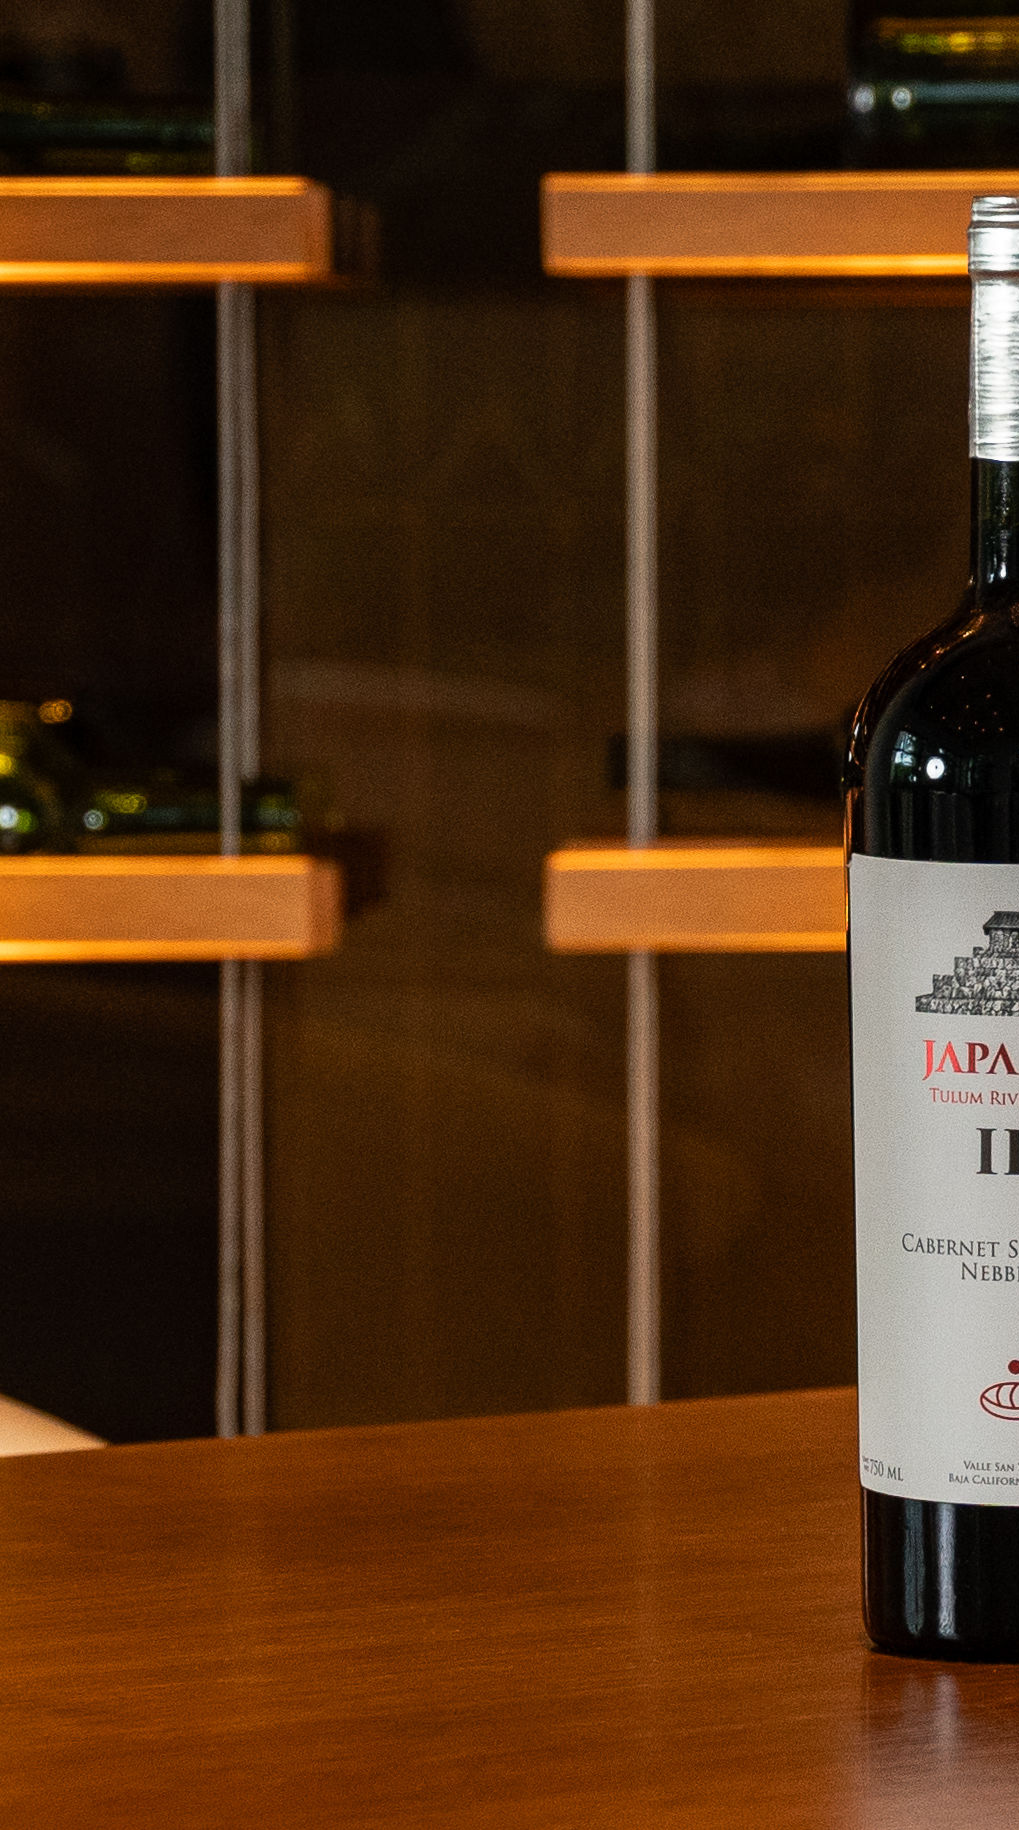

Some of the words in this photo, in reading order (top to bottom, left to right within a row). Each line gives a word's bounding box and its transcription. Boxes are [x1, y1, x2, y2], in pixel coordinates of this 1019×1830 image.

[922, 1040, 1019, 1080] JAPA
[929, 1088, 983, 1104] TULUM
[902, 1233, 1000, 1258] CABERNET
[870, 1459, 884, 1477] 750
[887, 1466, 904, 1482] ML
[963, 1460, 990, 1471] VALLE
[994, 1462, 1015, 1472] SAN
[949, 1473, 970, 1484] BAJA
